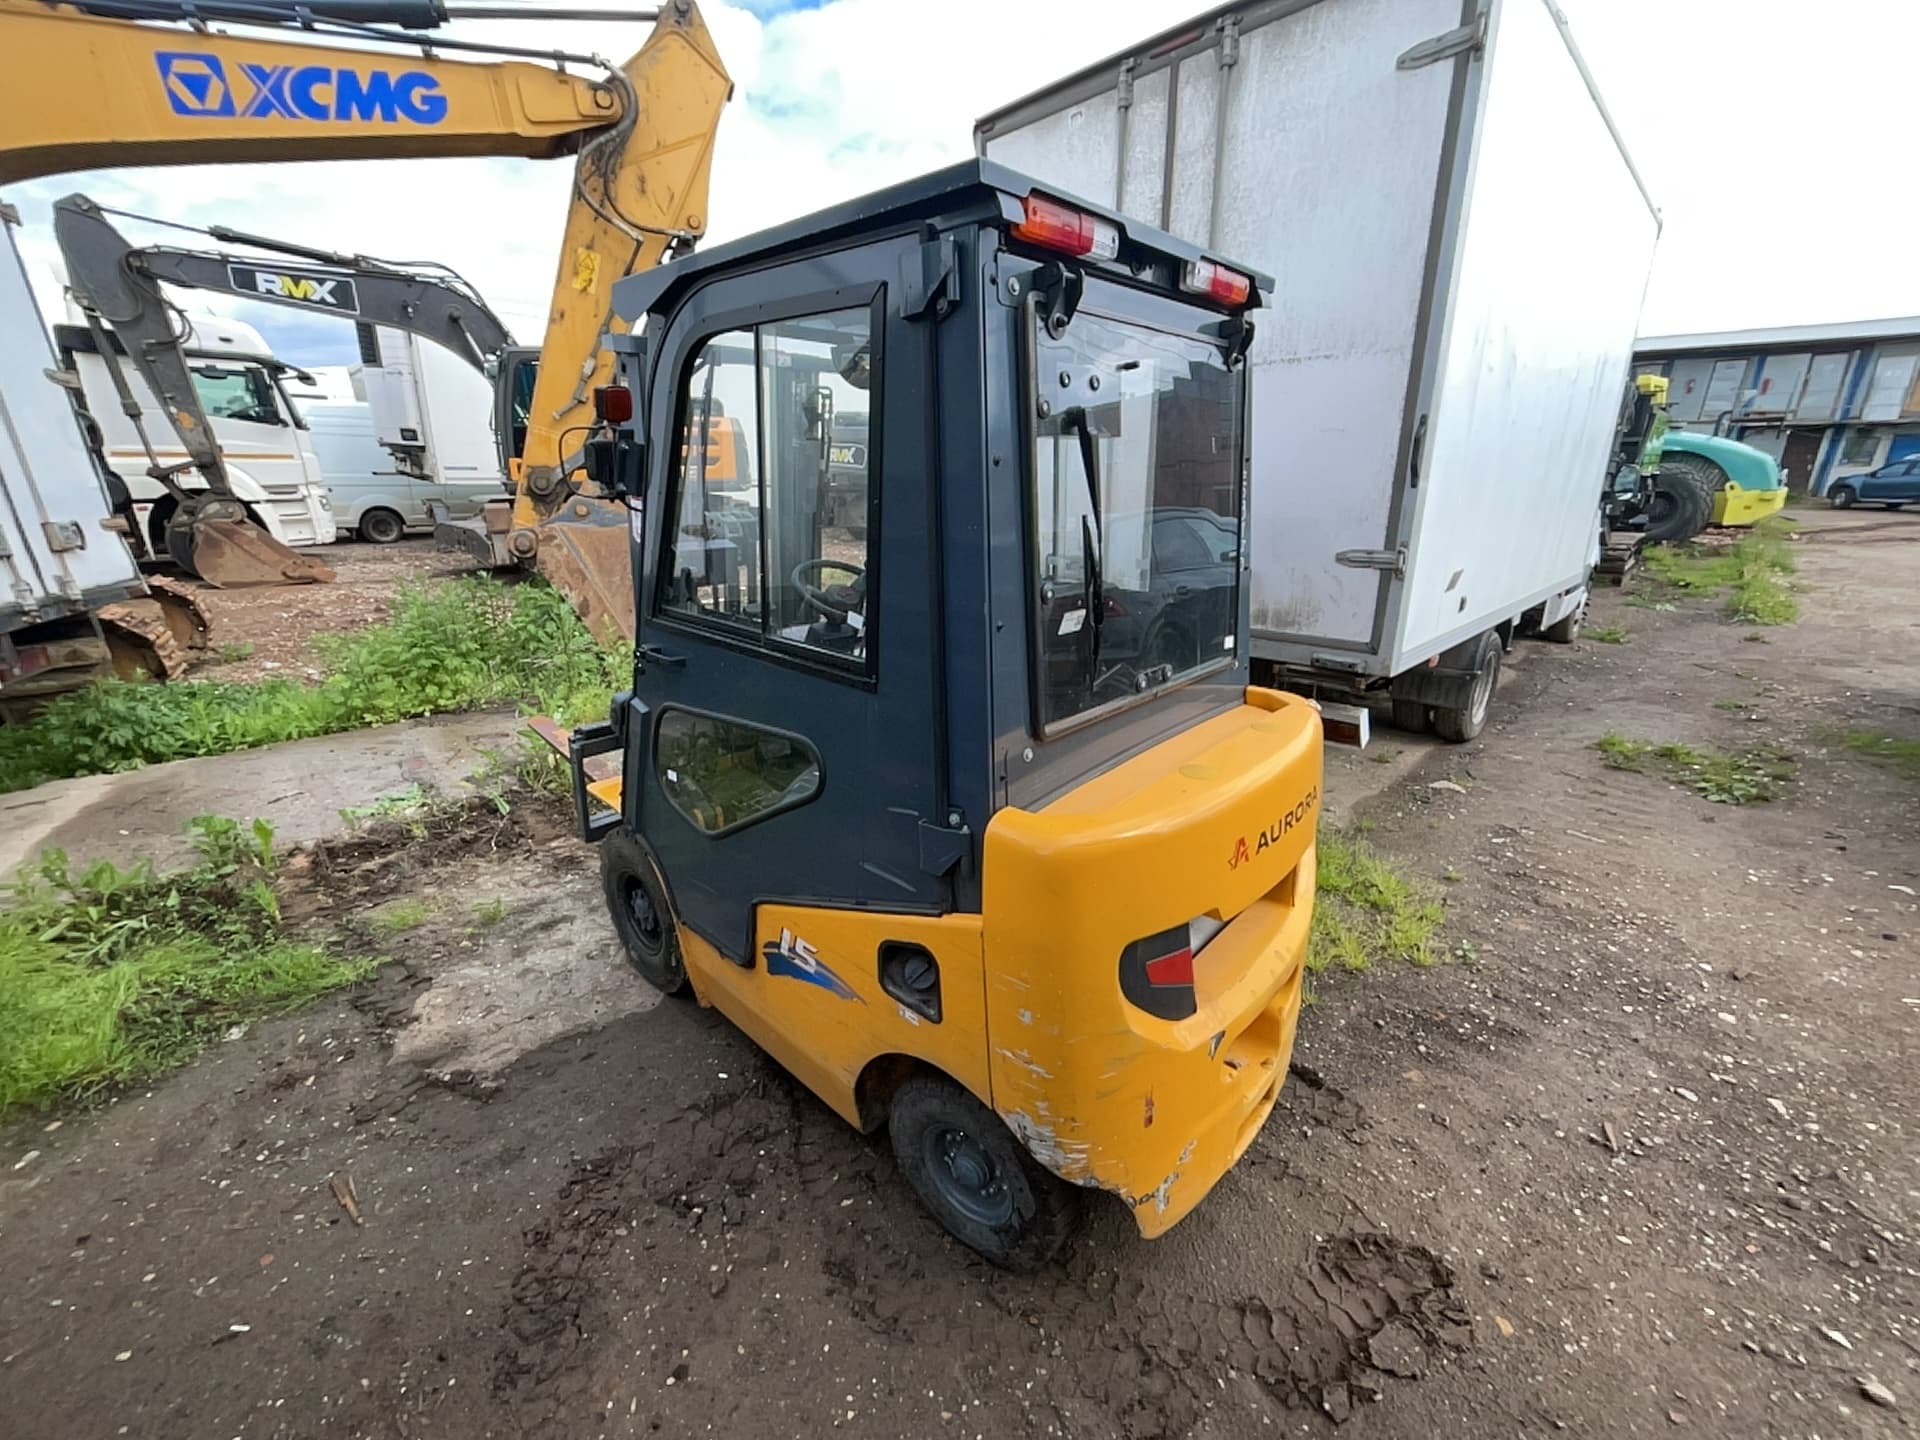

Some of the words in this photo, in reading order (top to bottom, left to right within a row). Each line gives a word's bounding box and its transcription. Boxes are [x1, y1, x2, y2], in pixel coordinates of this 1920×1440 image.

[237, 63, 448, 125] XCMG
[255, 271, 338, 305] RMX
[1255, 785, 1318, 856] AURORA
